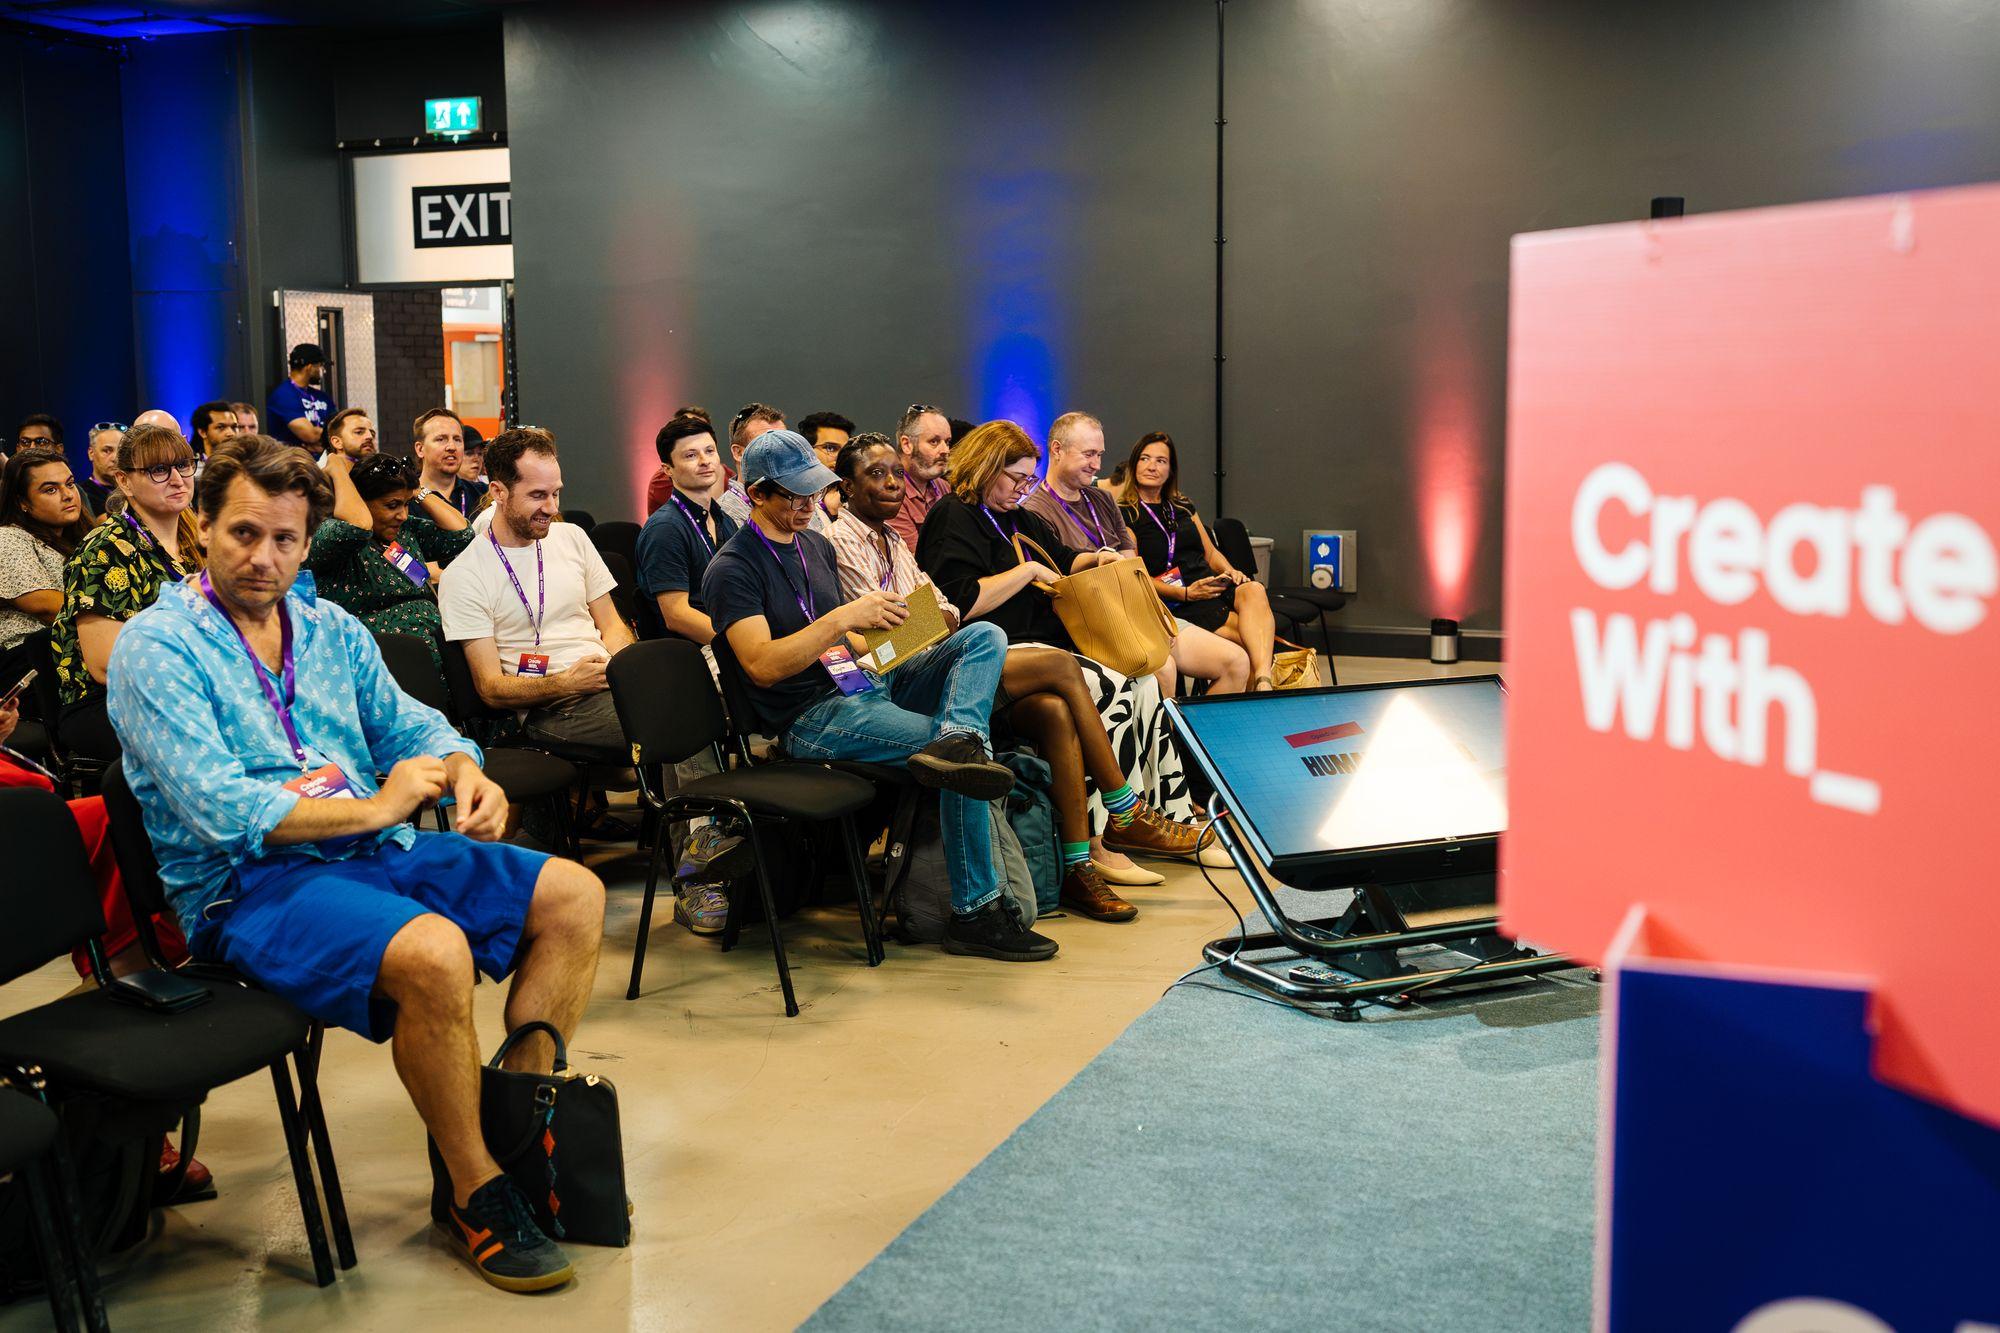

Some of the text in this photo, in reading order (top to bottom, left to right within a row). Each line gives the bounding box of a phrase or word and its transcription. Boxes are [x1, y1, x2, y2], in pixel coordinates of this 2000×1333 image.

[419, 191, 511, 240] EXIT
[1571, 461, 1999, 635] Create
[1569, 606, 1882, 815] With_
